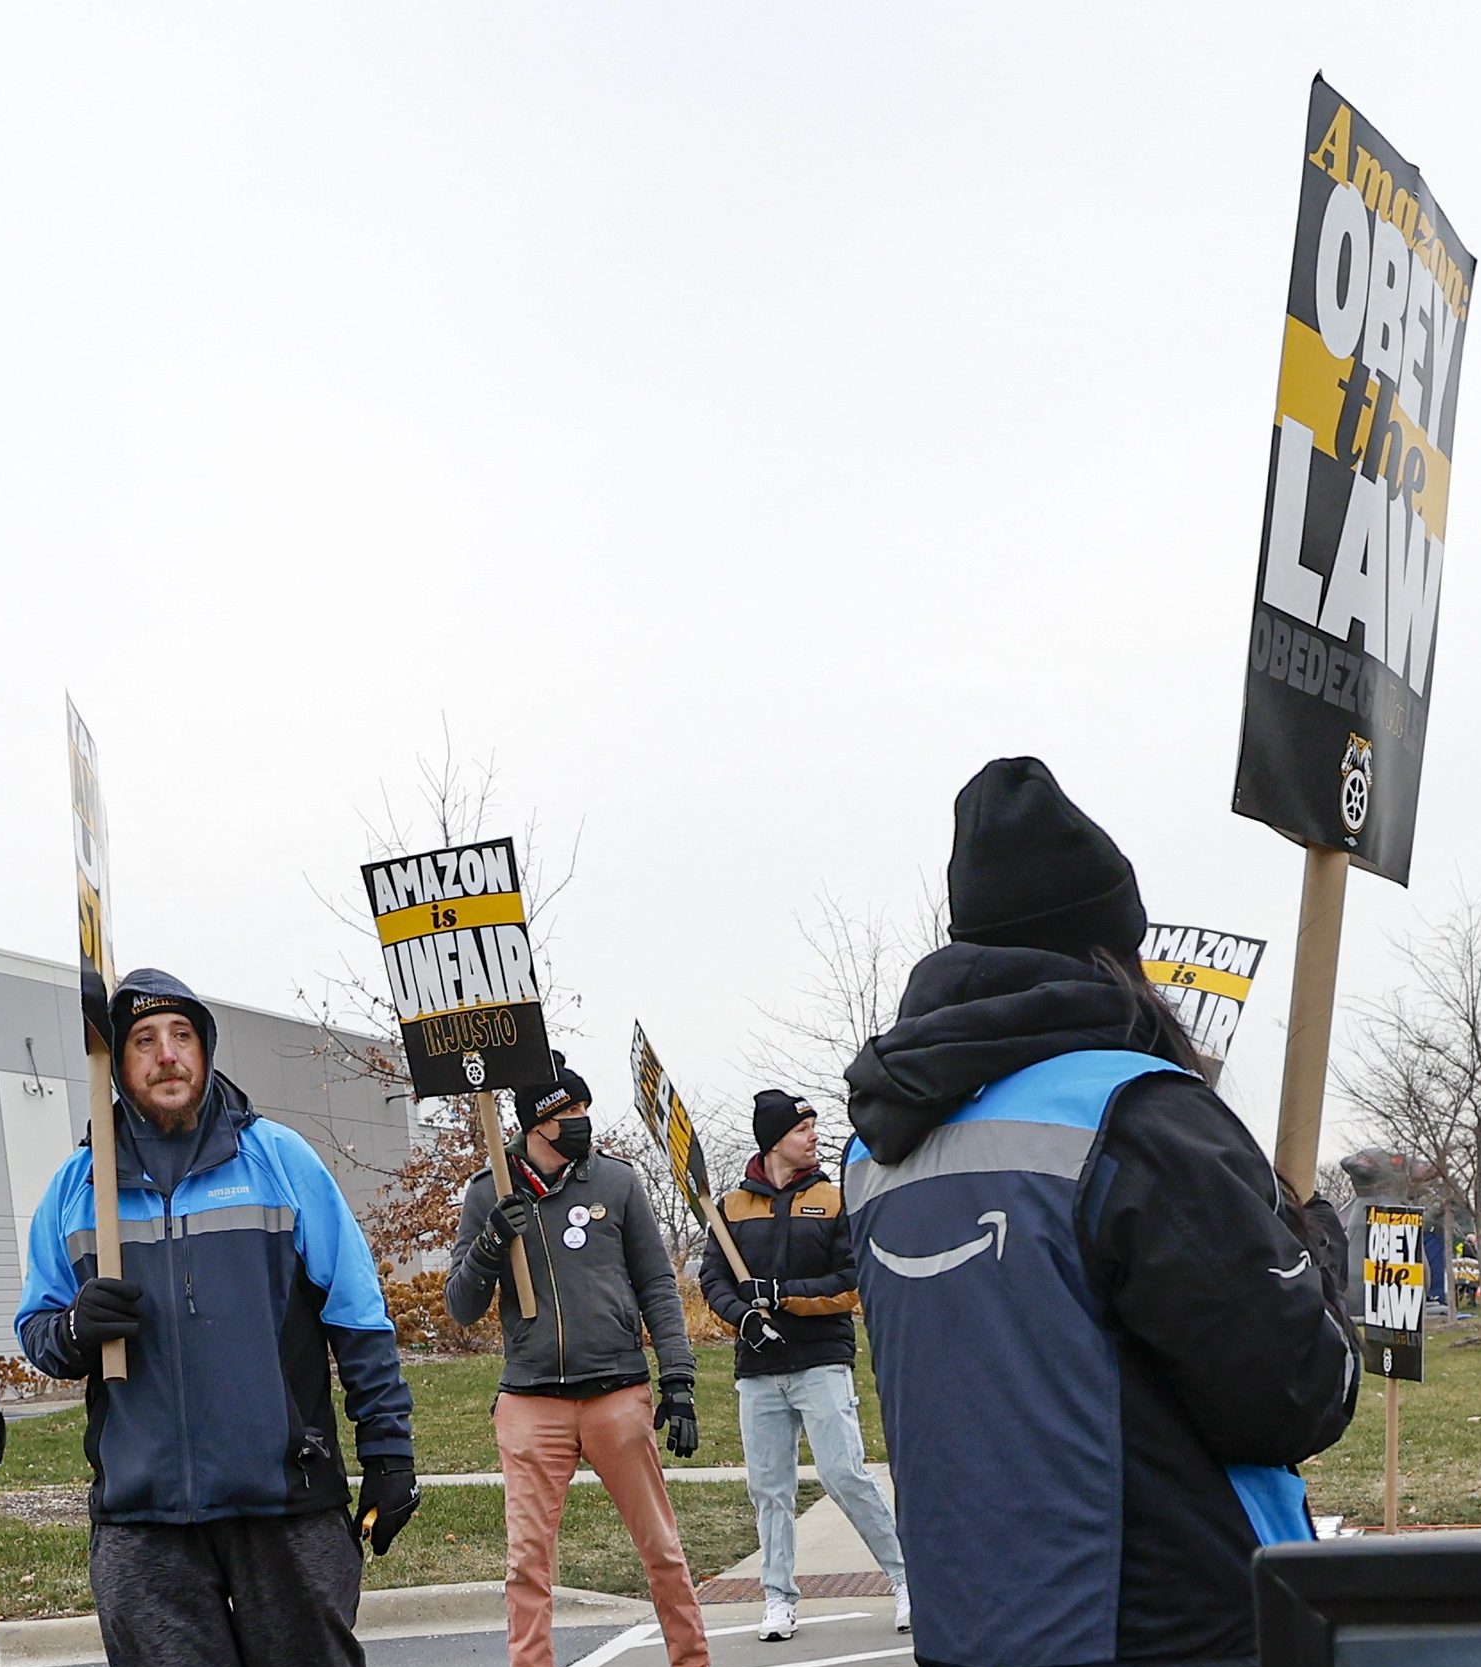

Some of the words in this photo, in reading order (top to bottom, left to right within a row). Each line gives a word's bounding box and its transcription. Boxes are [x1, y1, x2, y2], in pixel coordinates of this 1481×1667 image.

[1308, 103, 1470, 322] Amazon:
[1316, 184, 1459, 453] OBEY
[1336, 355, 1427, 502] the
[1263, 413, 1446, 698] LAW
[1250, 610, 1382, 724] OBEDEZC
[372, 846, 513, 916] AMAZON
[430, 904, 457, 929] is
[383, 925, 539, 1021] UNFAIR
[1139, 927, 1260, 978] AMAZON
[1171, 964, 1197, 985] is
[421, 1008, 517, 1057] INJUSTO
[534, 1088, 569, 1112] AMAZON
[207, 1186, 250, 1198] amazon
[1367, 1206, 1423, 1226] Amazon:
[1369, 1222, 1419, 1265] OBEY
[1374, 1258, 1410, 1286] the
[1365, 1280, 1424, 1331] LAW
